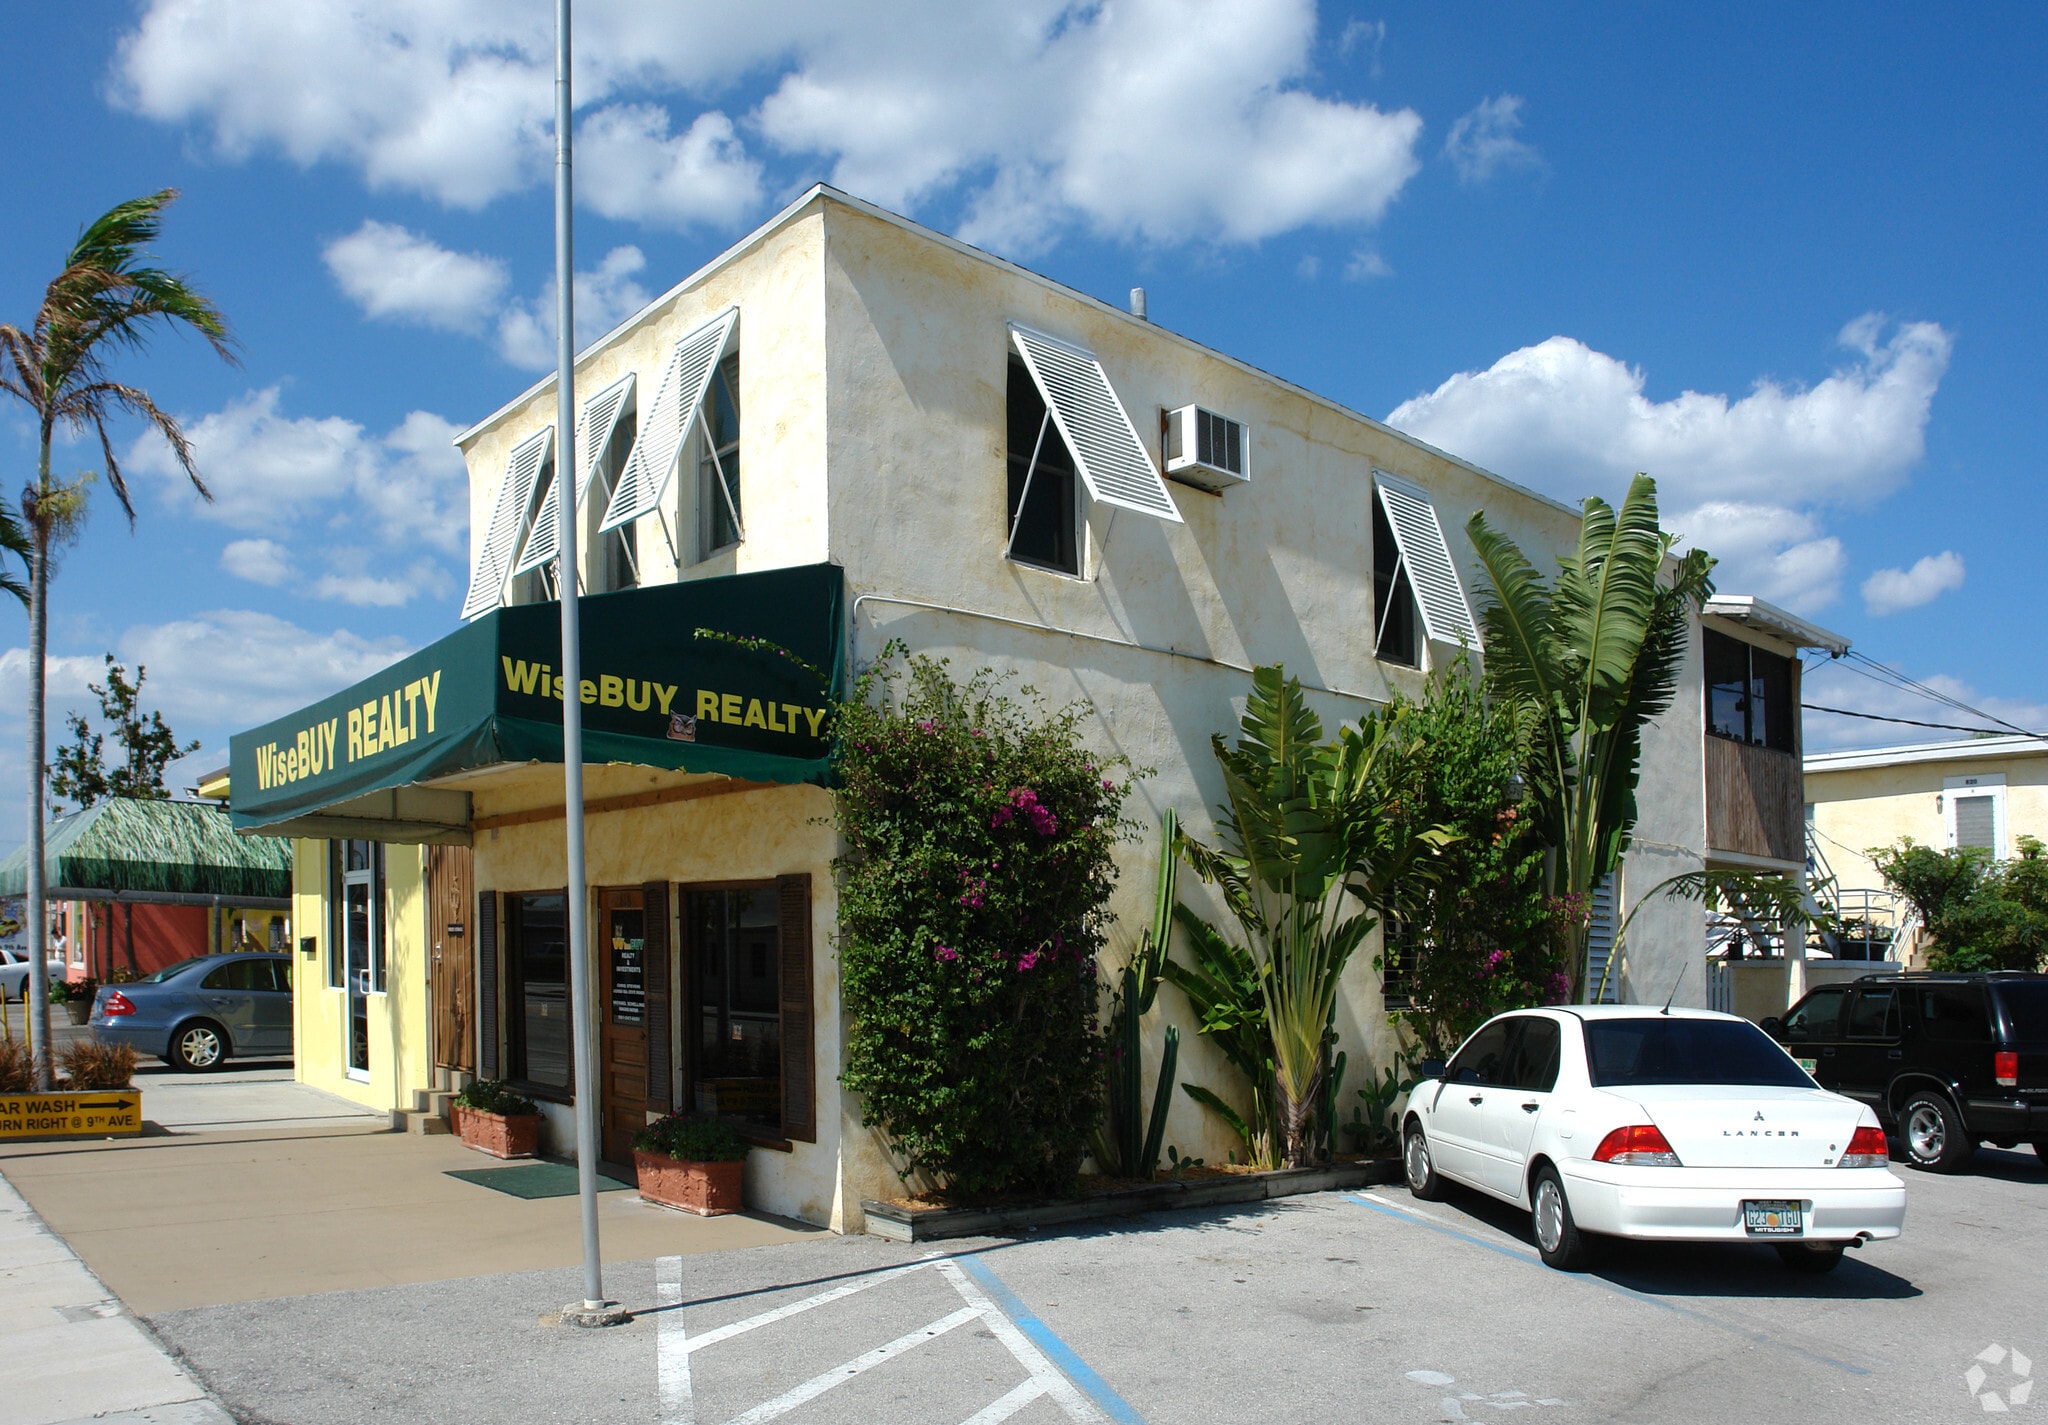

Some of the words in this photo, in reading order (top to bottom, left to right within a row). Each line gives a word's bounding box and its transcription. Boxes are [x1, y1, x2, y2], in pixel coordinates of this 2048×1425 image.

[696, 689, 827, 738] REALTY
[256, 718, 338, 790] WiseBUY
[347, 670, 442, 763] REALTY
[0, 1119, 22, 1131] RN
[27, 1117, 68, 1130] RIGHT
[71, 1116, 82, 1128] @
[87, 1116, 105, 1128] 9TH
[108, 1115, 136, 1127] AVE.
[25, 1100, 75, 1114] WASH
